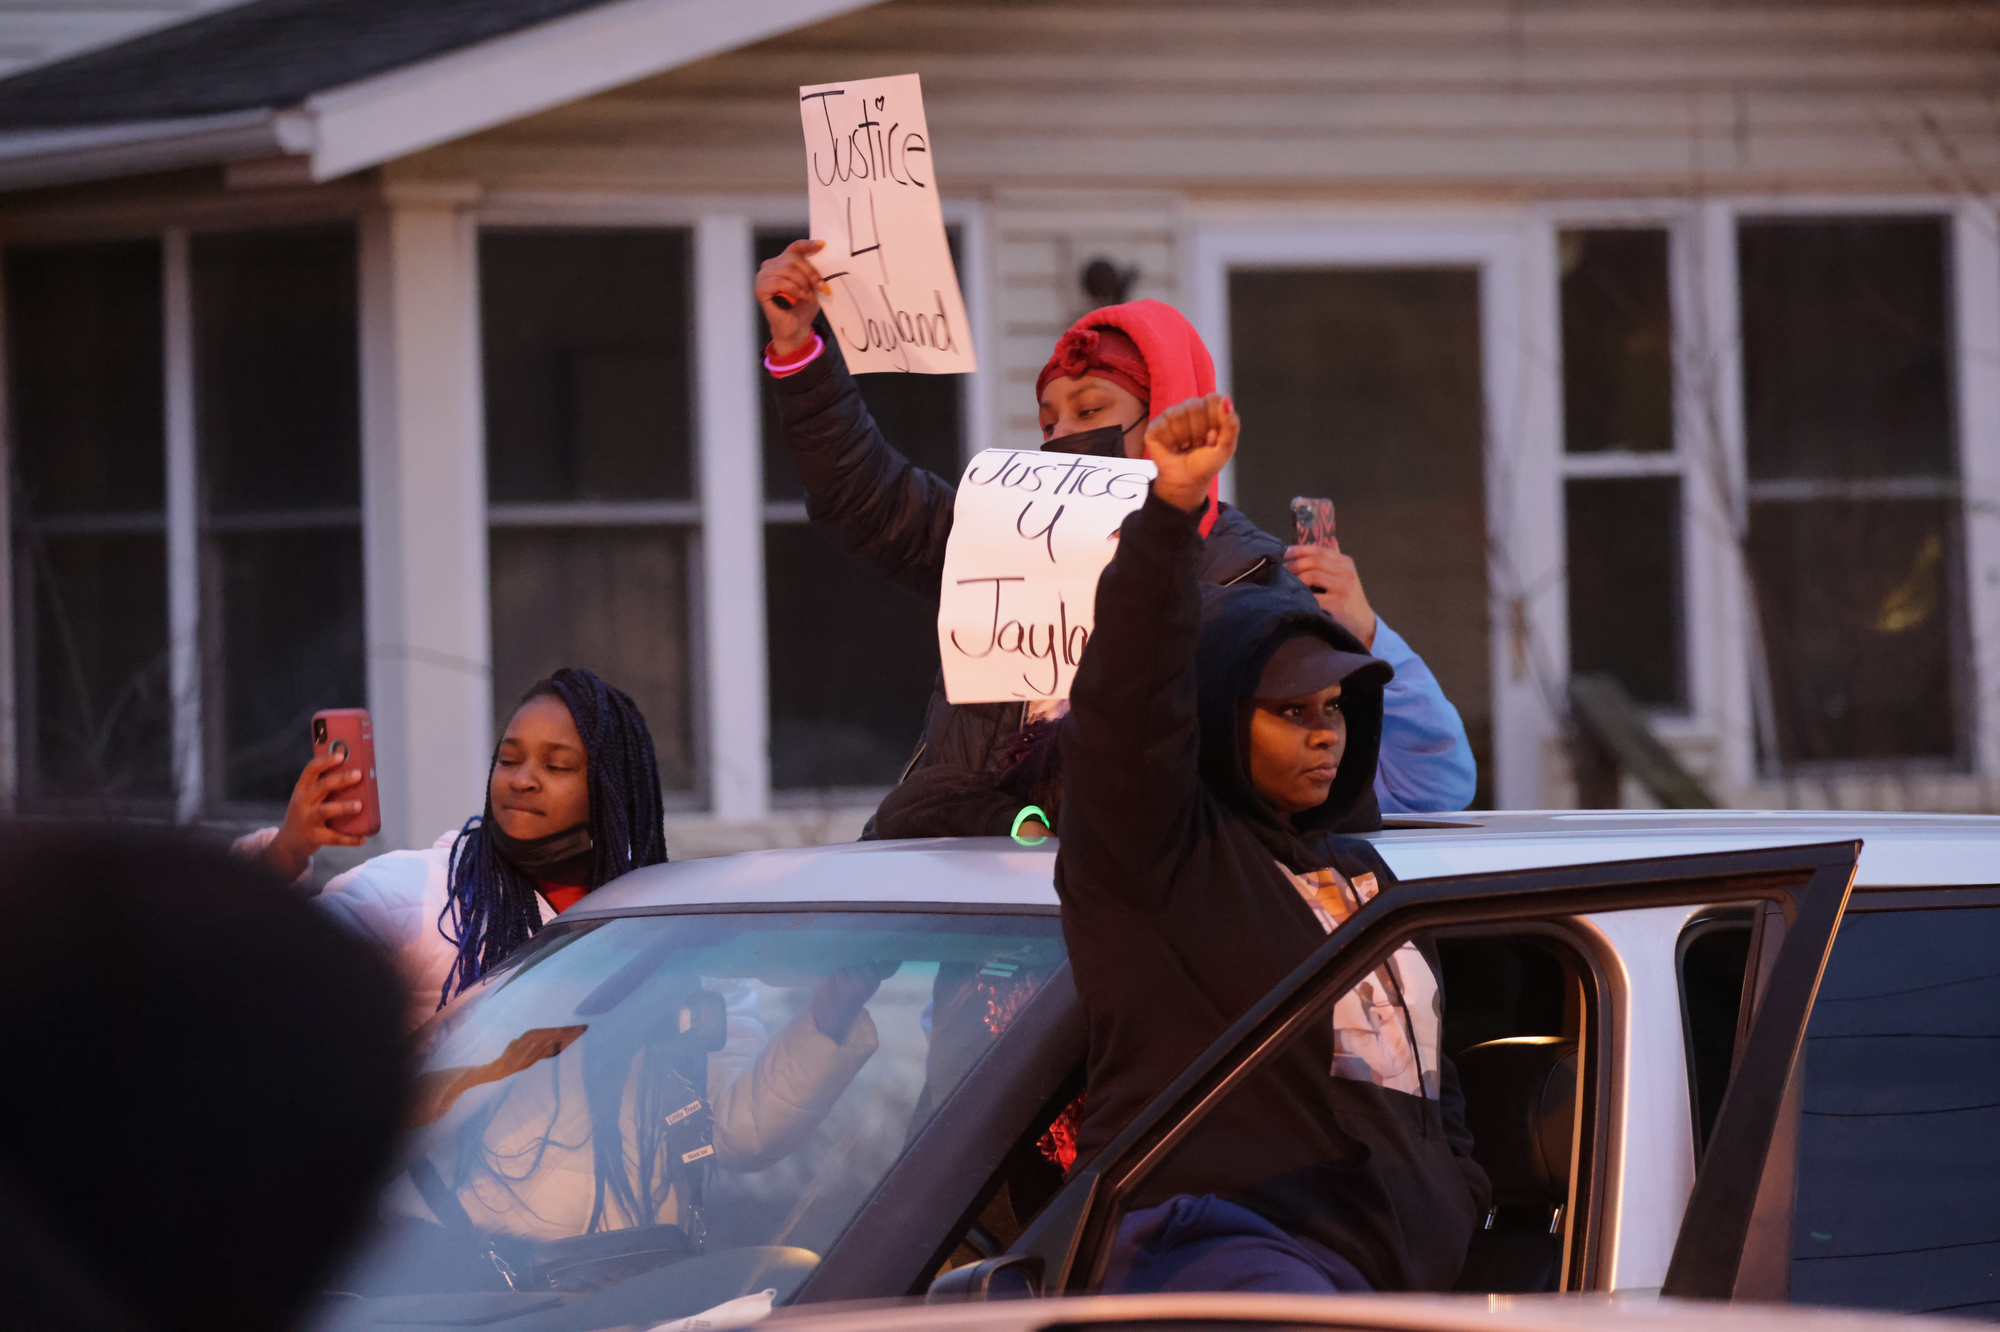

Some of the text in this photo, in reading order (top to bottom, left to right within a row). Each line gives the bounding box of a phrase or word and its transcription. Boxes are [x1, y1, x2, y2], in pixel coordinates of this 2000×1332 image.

[801, 90, 926, 188] Justice
[846, 187, 889, 286] 4
[822, 271, 960, 373] Jayland
[968, 450, 1151, 500] Justice
[668, 1104, 699, 1124] Little Trees
